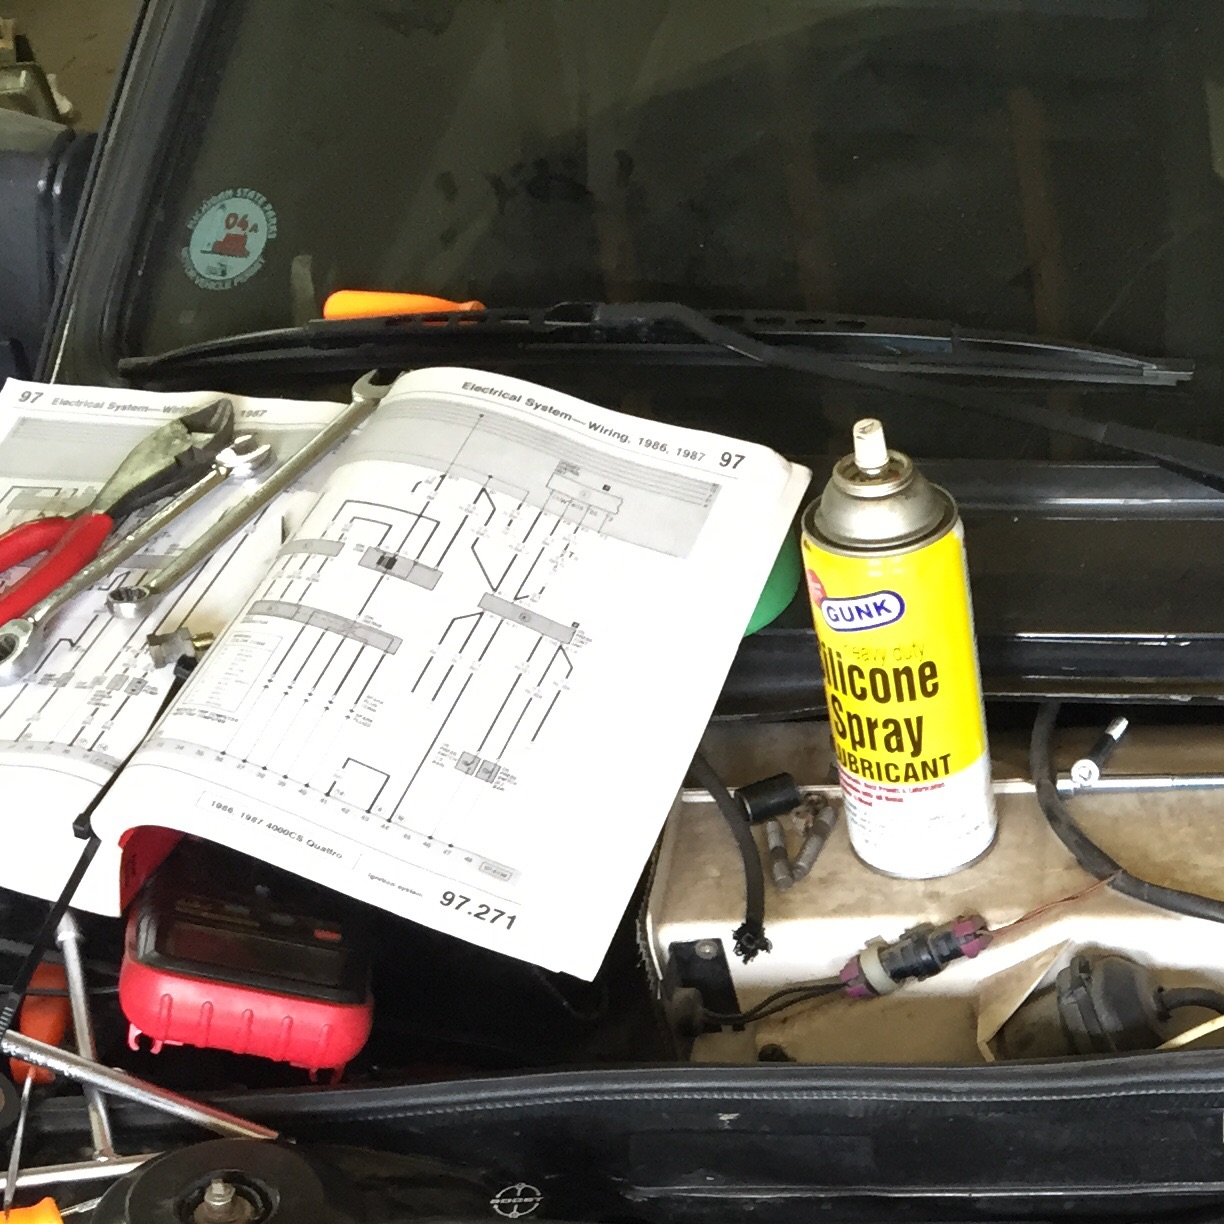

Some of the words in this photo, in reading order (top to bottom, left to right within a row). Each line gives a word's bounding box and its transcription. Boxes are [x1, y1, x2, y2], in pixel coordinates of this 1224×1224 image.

[18, 391, 43, 405] 97
[51, 397, 105, 411] Electrical
[461, 380, 522, 403] Electrical
[637, 436, 670, 455] 1986,
[676, 446, 706, 463] 1987
[719, 450, 746, 470] 97
[825, 600, 894, 625] GUNK
[820, 641, 940, 704] ilicone
[831, 693, 924, 758] Spray
[837, 744, 952, 783] UBRICANT
[306, 839, 343, 859] Quattro
[440, 890, 518, 931] 97.271
